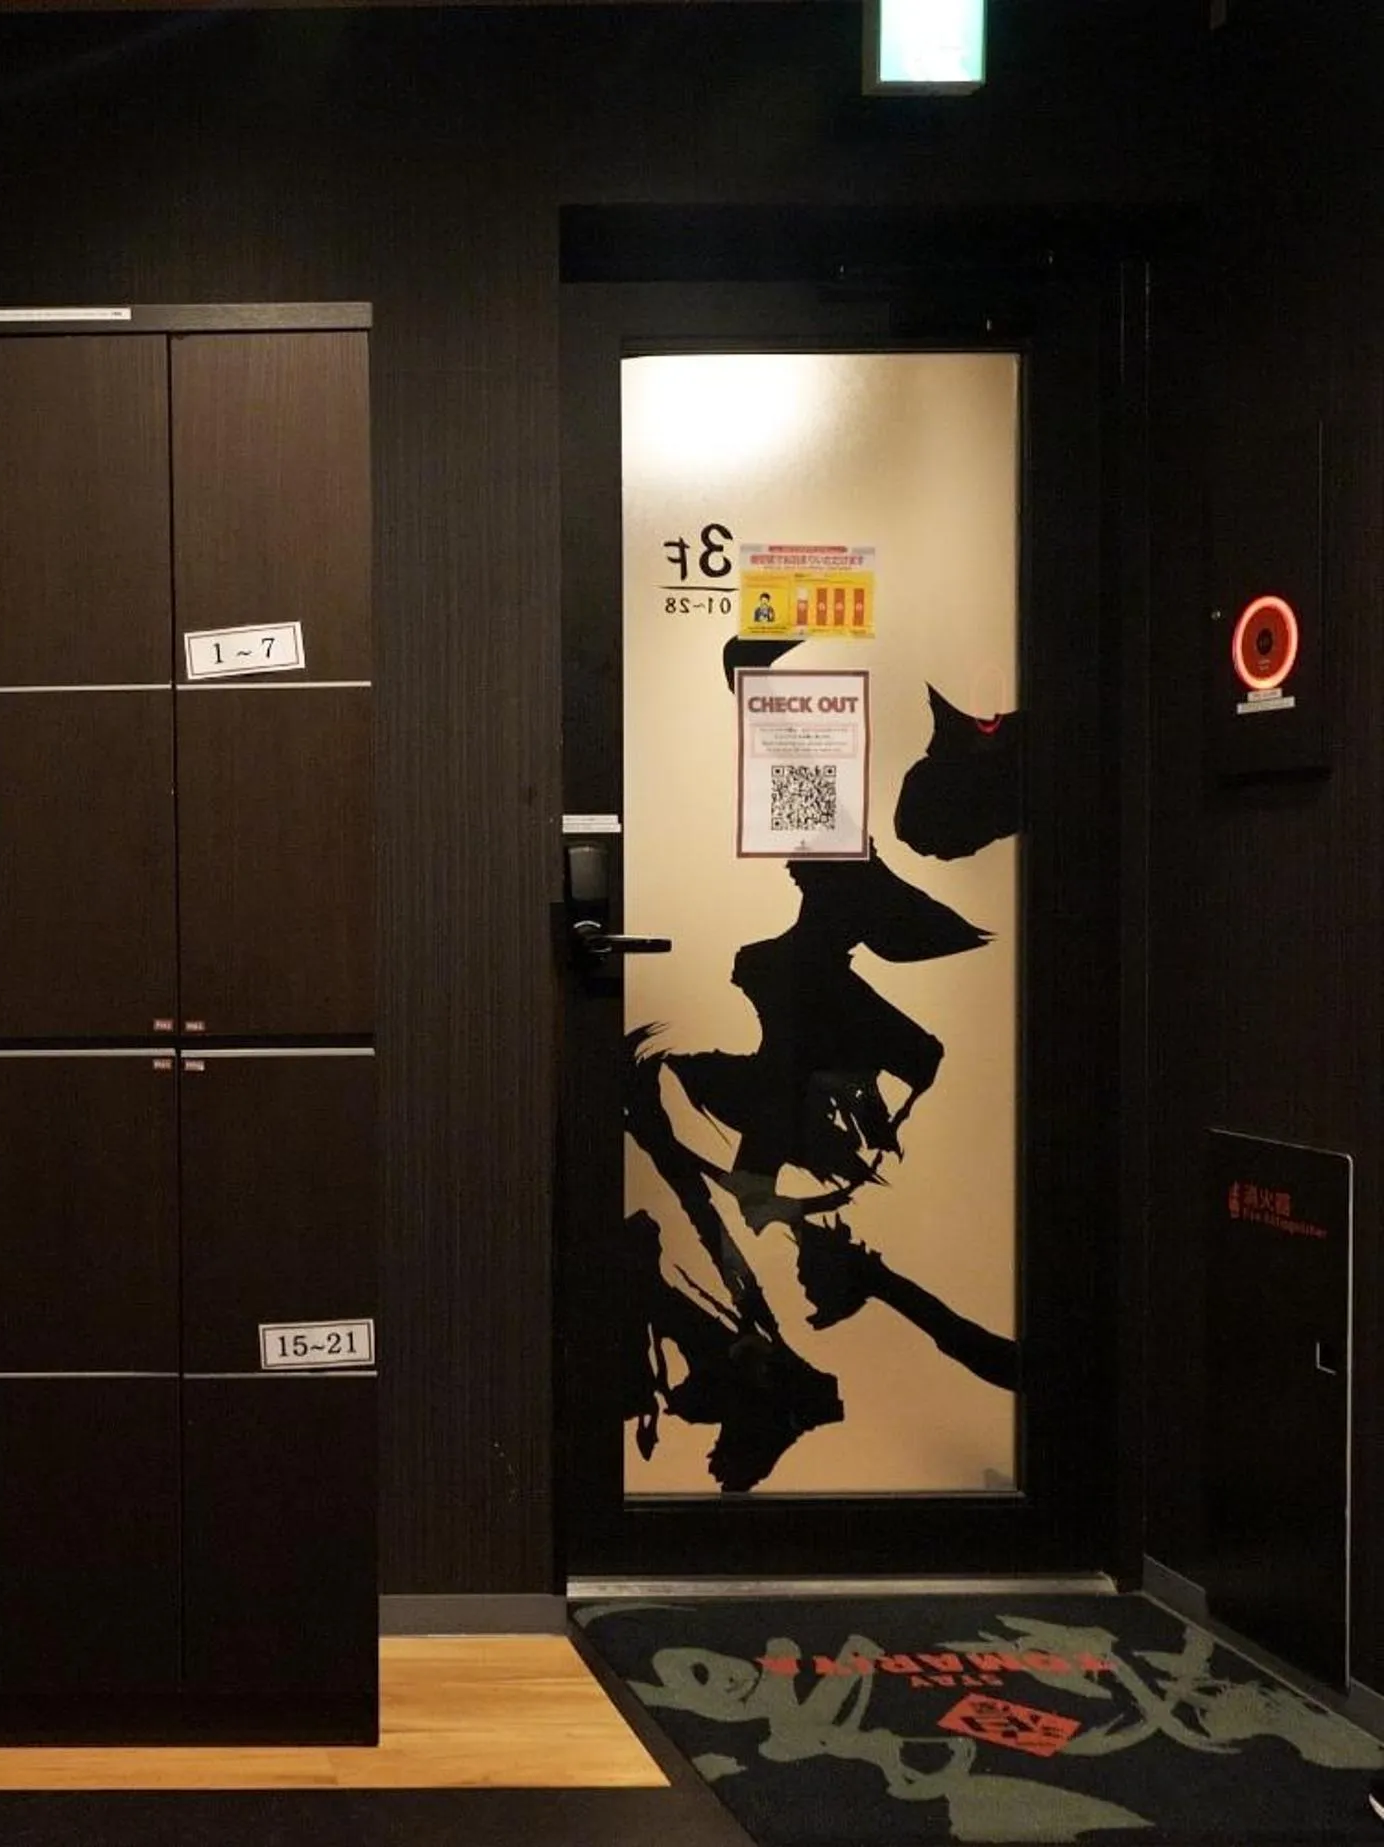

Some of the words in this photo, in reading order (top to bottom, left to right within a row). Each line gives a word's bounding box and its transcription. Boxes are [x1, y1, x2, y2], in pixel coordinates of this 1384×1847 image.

[747, 695, 813, 714] CHECK
[817, 695, 859, 714] OUT
[278, 1331, 357, 1357] 15~21
